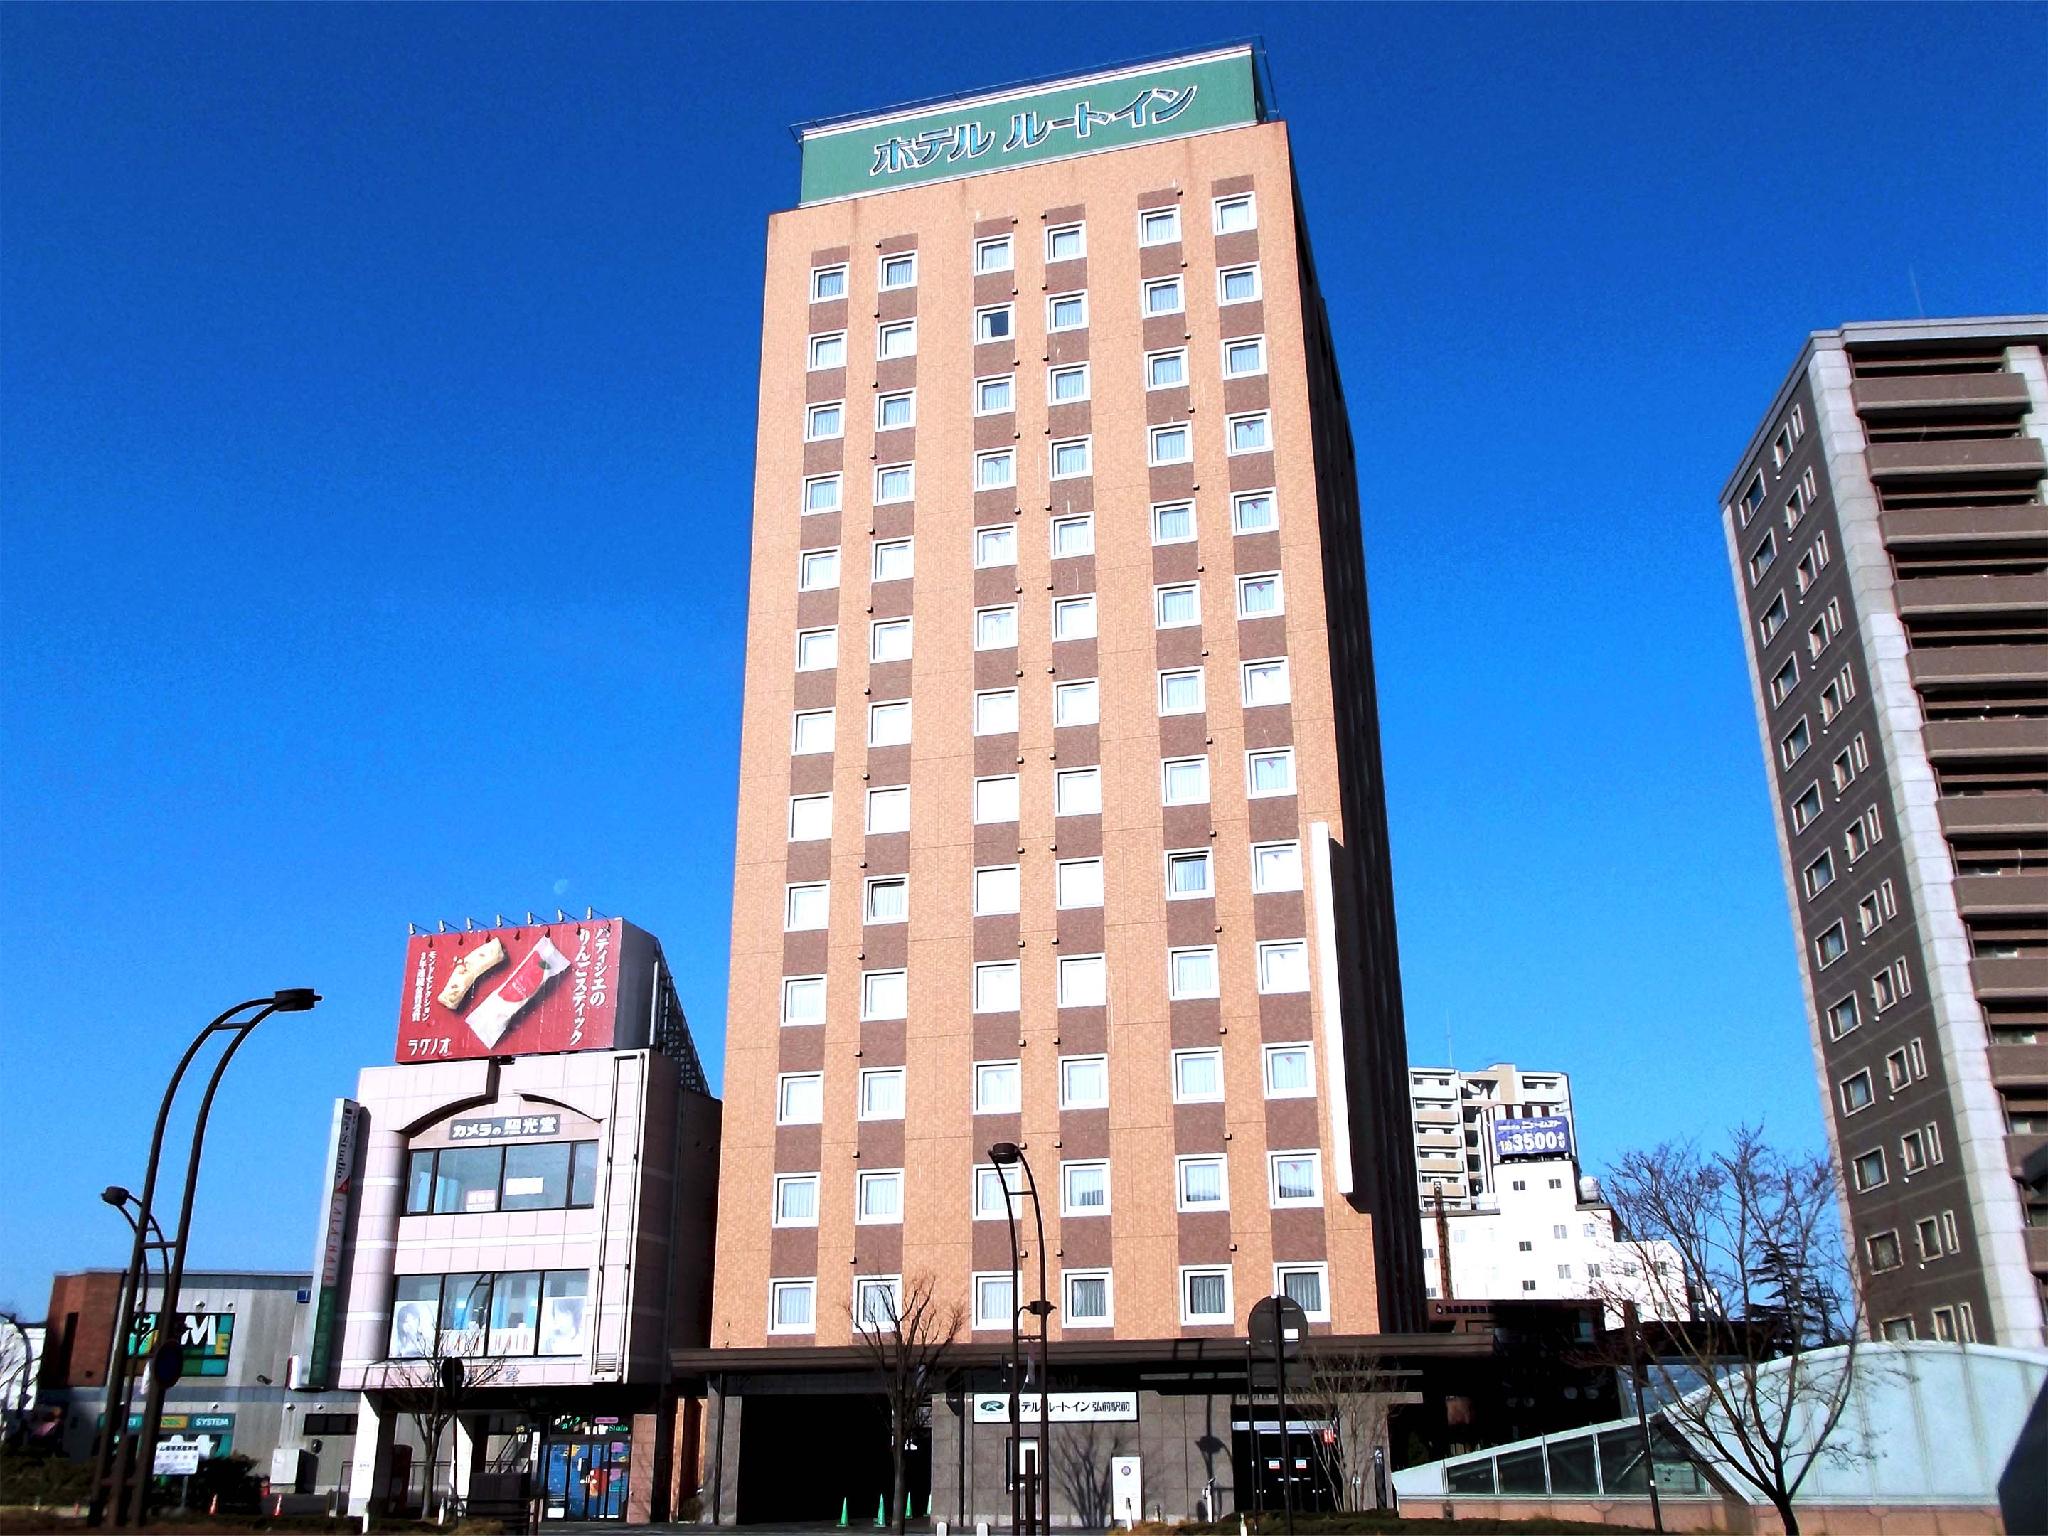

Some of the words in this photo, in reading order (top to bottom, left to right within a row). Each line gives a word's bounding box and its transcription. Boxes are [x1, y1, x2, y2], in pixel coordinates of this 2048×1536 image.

[869, 120, 995, 176] ホテル
[1002, 85, 1198, 153] ルートイン
